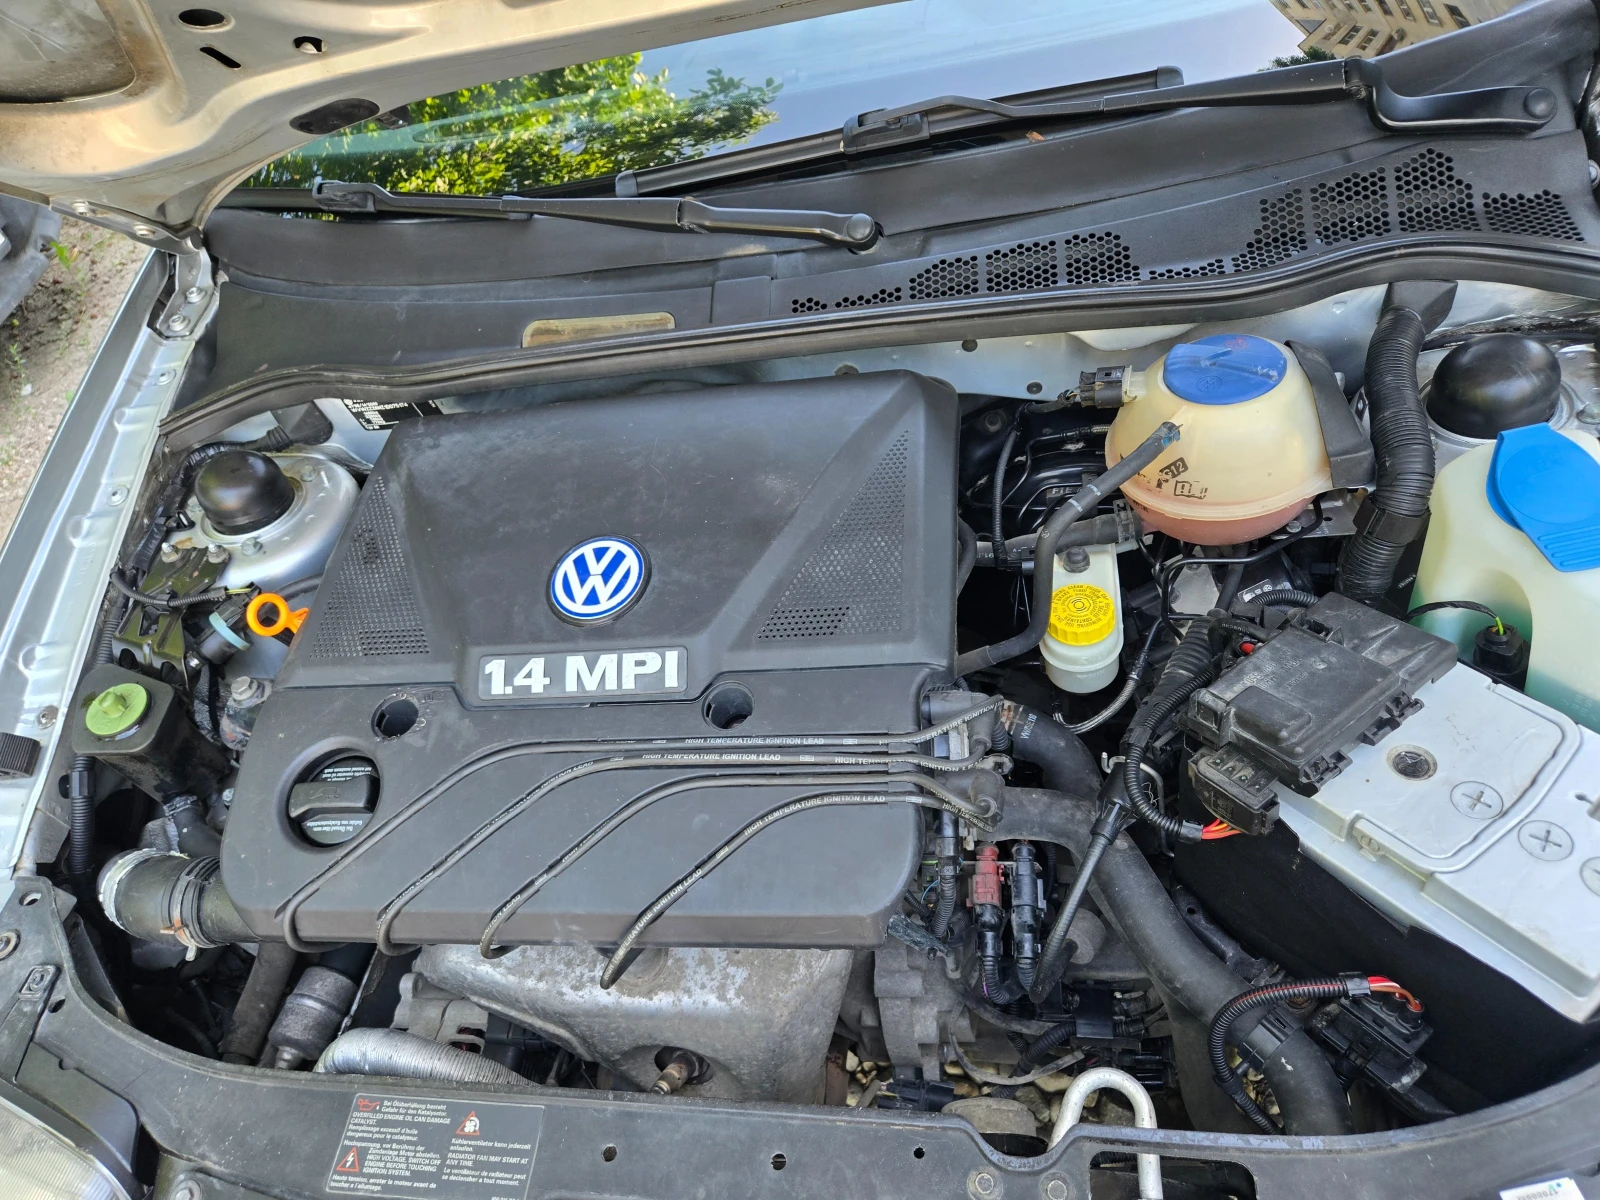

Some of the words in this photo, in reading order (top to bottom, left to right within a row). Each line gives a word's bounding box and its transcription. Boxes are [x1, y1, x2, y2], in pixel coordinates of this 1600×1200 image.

[1163, 462, 1184, 478] G12
[551, 536, 644, 620] VW
[484, 658, 550, 695] 1.4
[565, 650, 679, 692] MPI
[920, 760, 959, 772] IGNITION
[744, 819, 762, 836] HIGH
[764, 797, 822, 822] TEMPERATURE
[653, 884, 683, 912] IGNITION
[683, 869, 702, 886] LEAD
[348, 1124, 379, 1132] Remplissage
[344, 1140, 380, 1148] Hochspannung,
[452, 1138, 494, 1147] Kühlerventilator
